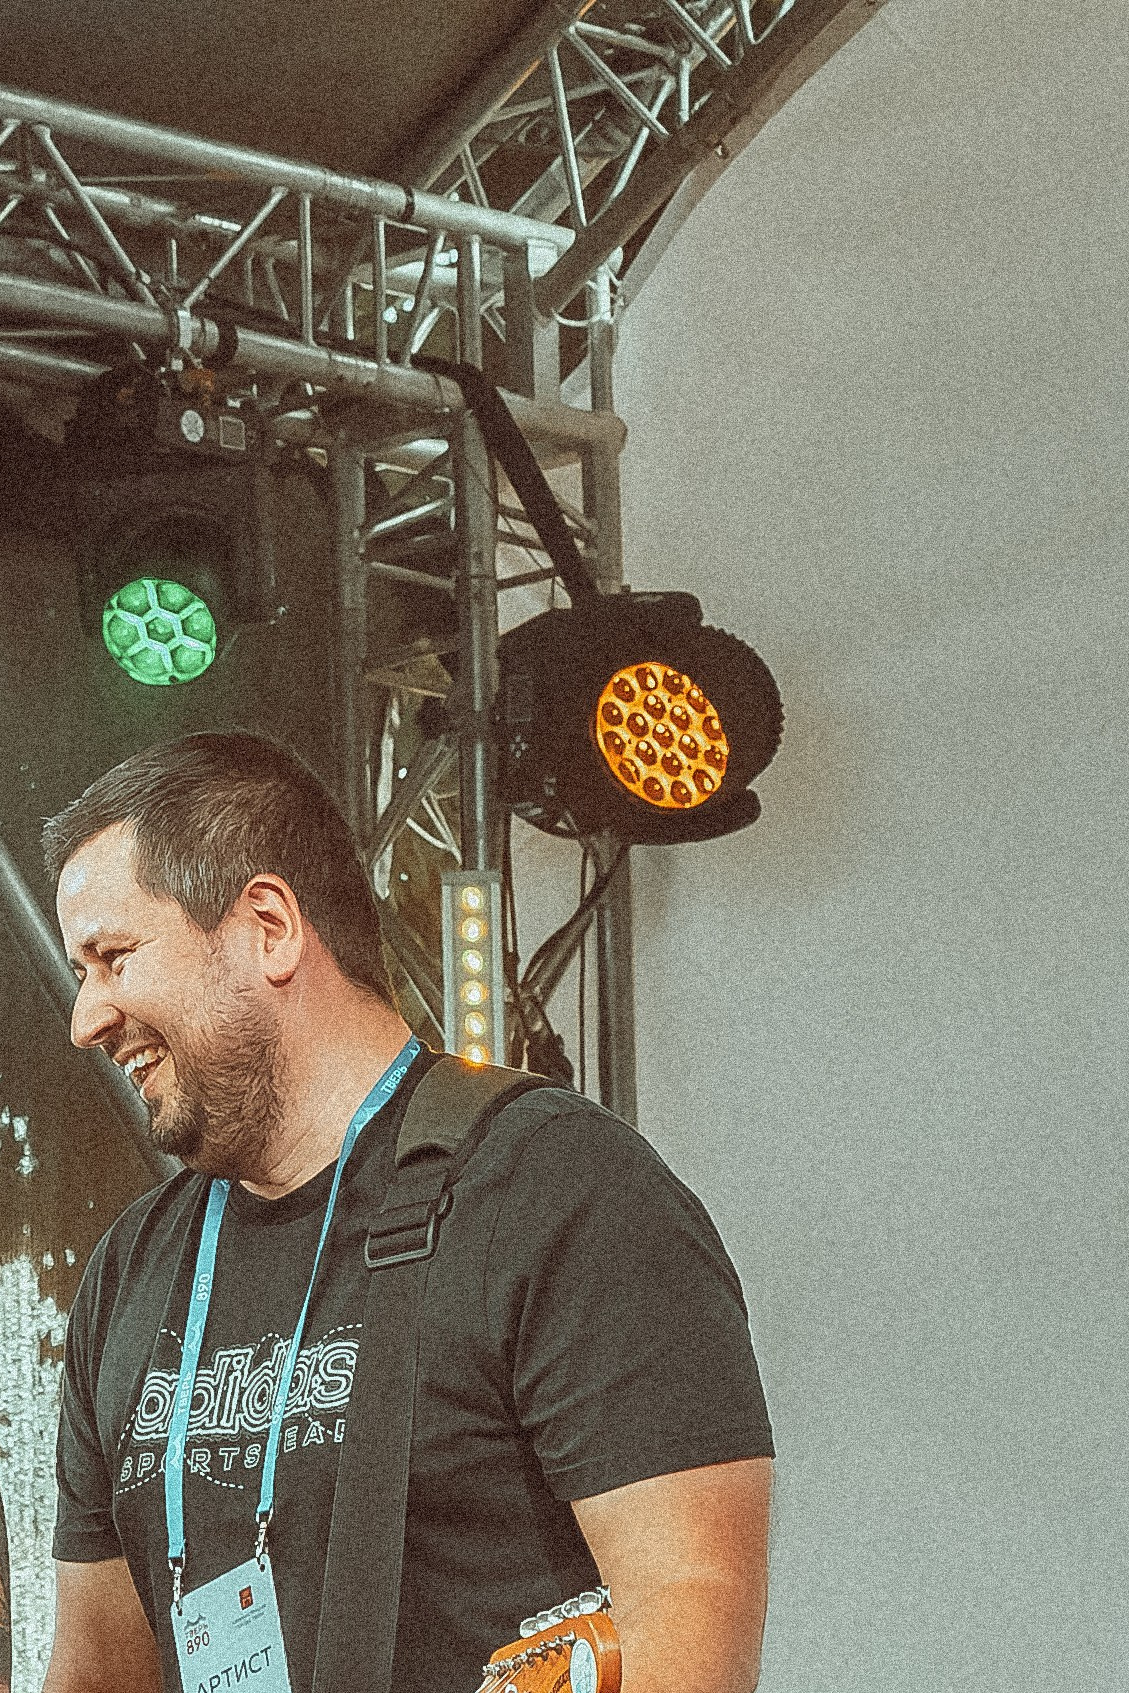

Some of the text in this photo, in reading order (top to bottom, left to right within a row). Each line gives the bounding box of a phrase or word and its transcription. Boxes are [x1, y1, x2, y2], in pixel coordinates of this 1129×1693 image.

[380, 1065, 408, 1094] ТВЕРЬ
[196, 1273, 211, 1301] 890
[121, 1418, 346, 1482] SPRTSEA
[187, 1631, 210, 1655] 890
